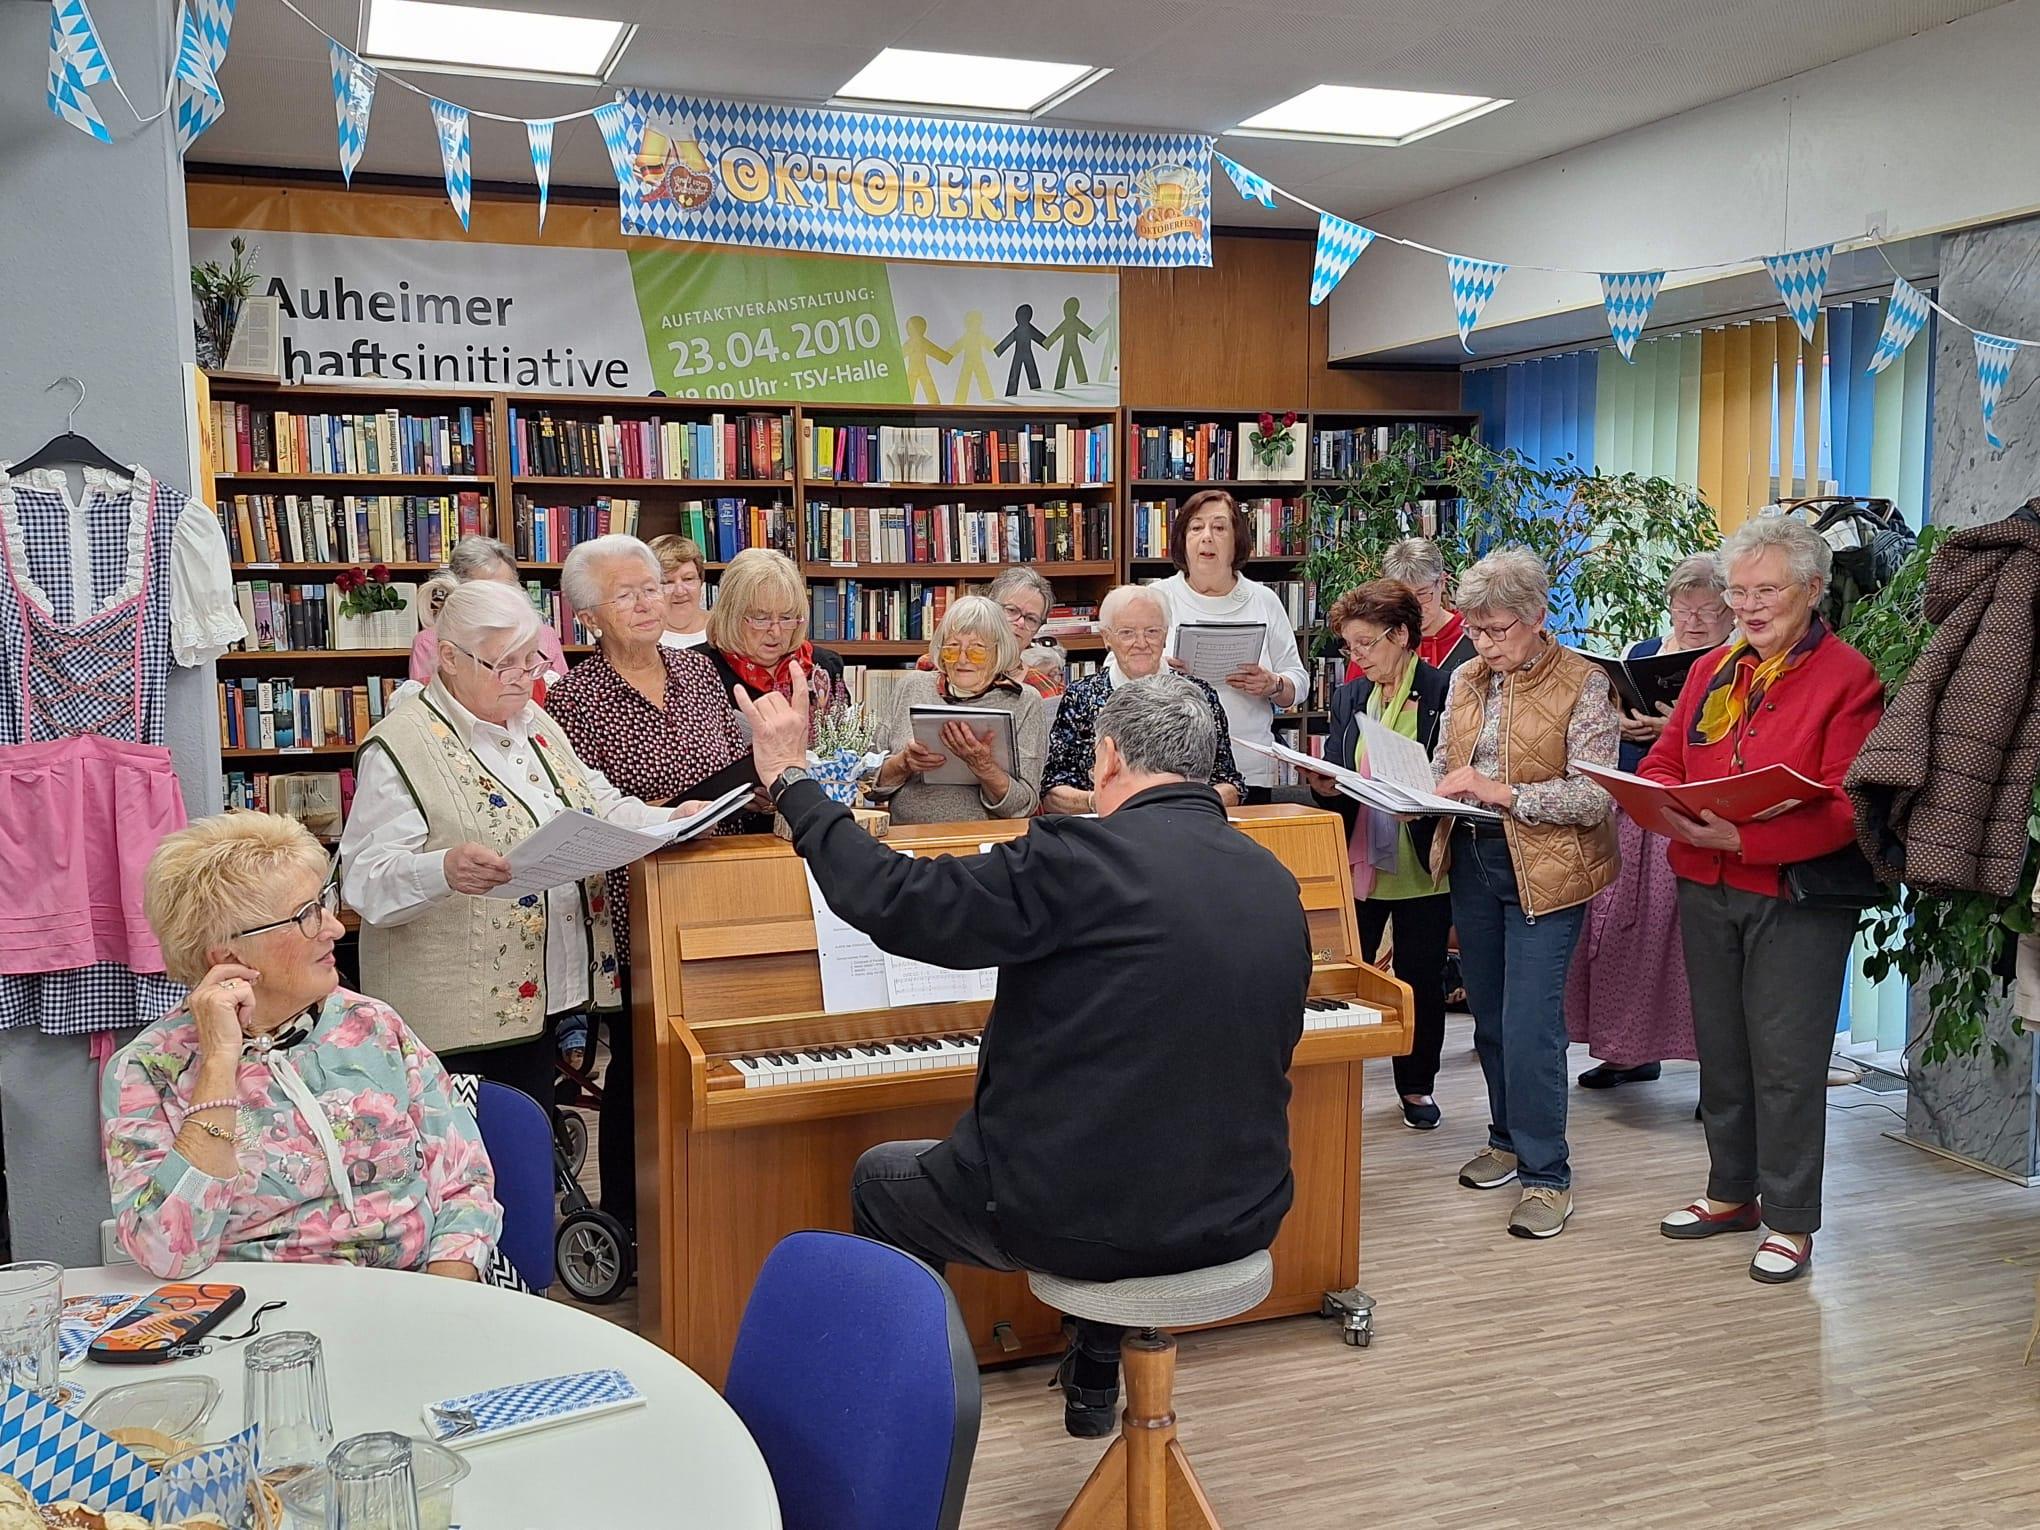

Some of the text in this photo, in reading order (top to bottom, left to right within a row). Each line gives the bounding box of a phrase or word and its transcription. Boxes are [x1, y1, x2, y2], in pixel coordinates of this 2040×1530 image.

[718, 145, 1131, 227] OKTOBERFEST
[1139, 219, 1198, 235] OKTOBERFEST
[265, 276, 513, 327] Auheimer
[661, 287, 875, 329] AUFTAKTVERANSTALTUNG:
[667, 313, 881, 377] 23.04.2010
[676, 359, 889, 399] 900 Uhr TSV-Halle
[388, 420, 398, 462] Blechtrommel
